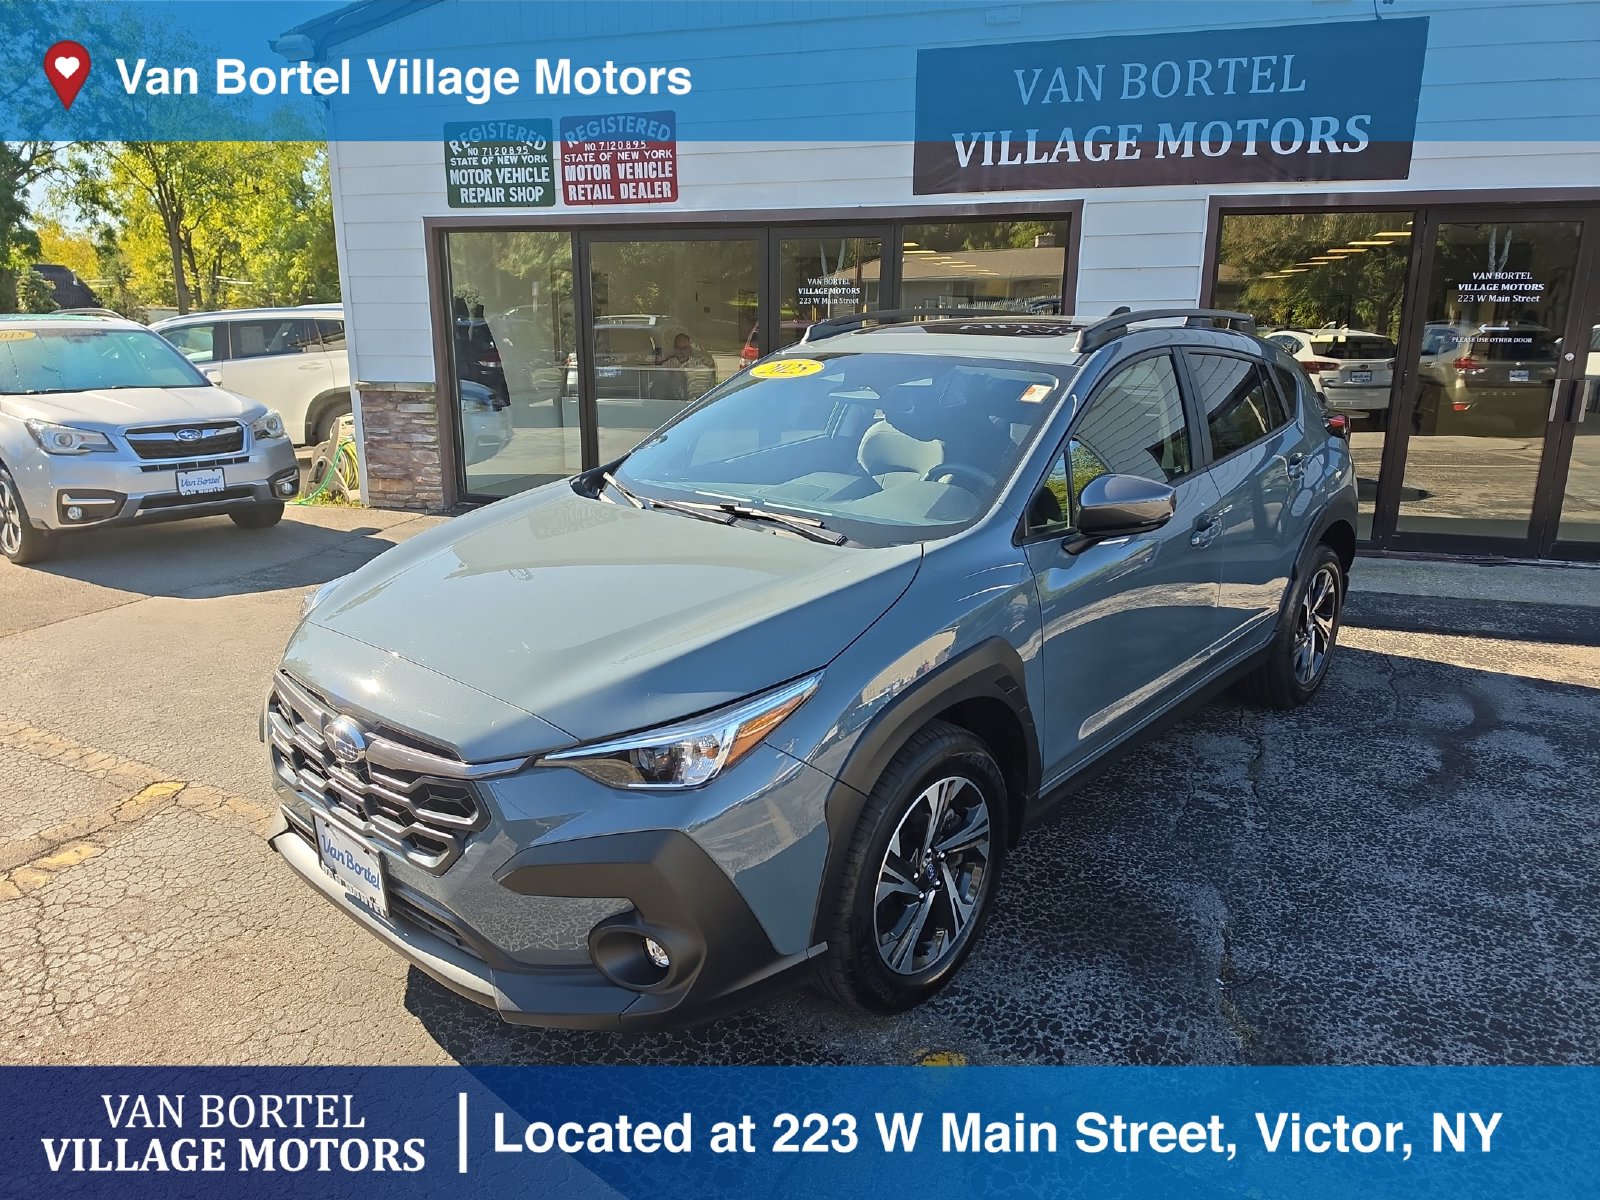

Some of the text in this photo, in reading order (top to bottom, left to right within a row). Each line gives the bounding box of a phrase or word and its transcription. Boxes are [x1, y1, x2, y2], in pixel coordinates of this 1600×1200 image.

[1013, 54, 1307, 105] VAN BORTEL
[449, 122, 547, 155] REGISTERED
[564, 115, 671, 149] REGISTERED
[598, 140, 647, 151] 7120895
[952, 114, 1372, 168] VILLAGE MOTORS
[481, 145, 529, 156] 7120895
[564, 149, 673, 163] STATE OF NEW YORK
[450, 154, 548, 166] STATE OF NEW YORK
[449, 166, 550, 185] MOTOR VEHICLE
[564, 160, 673, 182] MOTOR VEHICLE
[460, 185, 544, 204] REPAIR SHOP
[567, 181, 672, 202] RETAIL DEALER
[807, 278, 822, 286] VAN
[1472, 272, 1533, 280] VAN BORTEL
[798, 287, 861, 295] VILLAGE MOTORS
[1458, 283, 1545, 291] VILLAGE MOTORS
[799, 297, 812, 305] 223
[821, 297, 838, 305] Main
[839, 297, 859, 305] Street
[1457, 294, 1541, 303] 223 W Main Street
